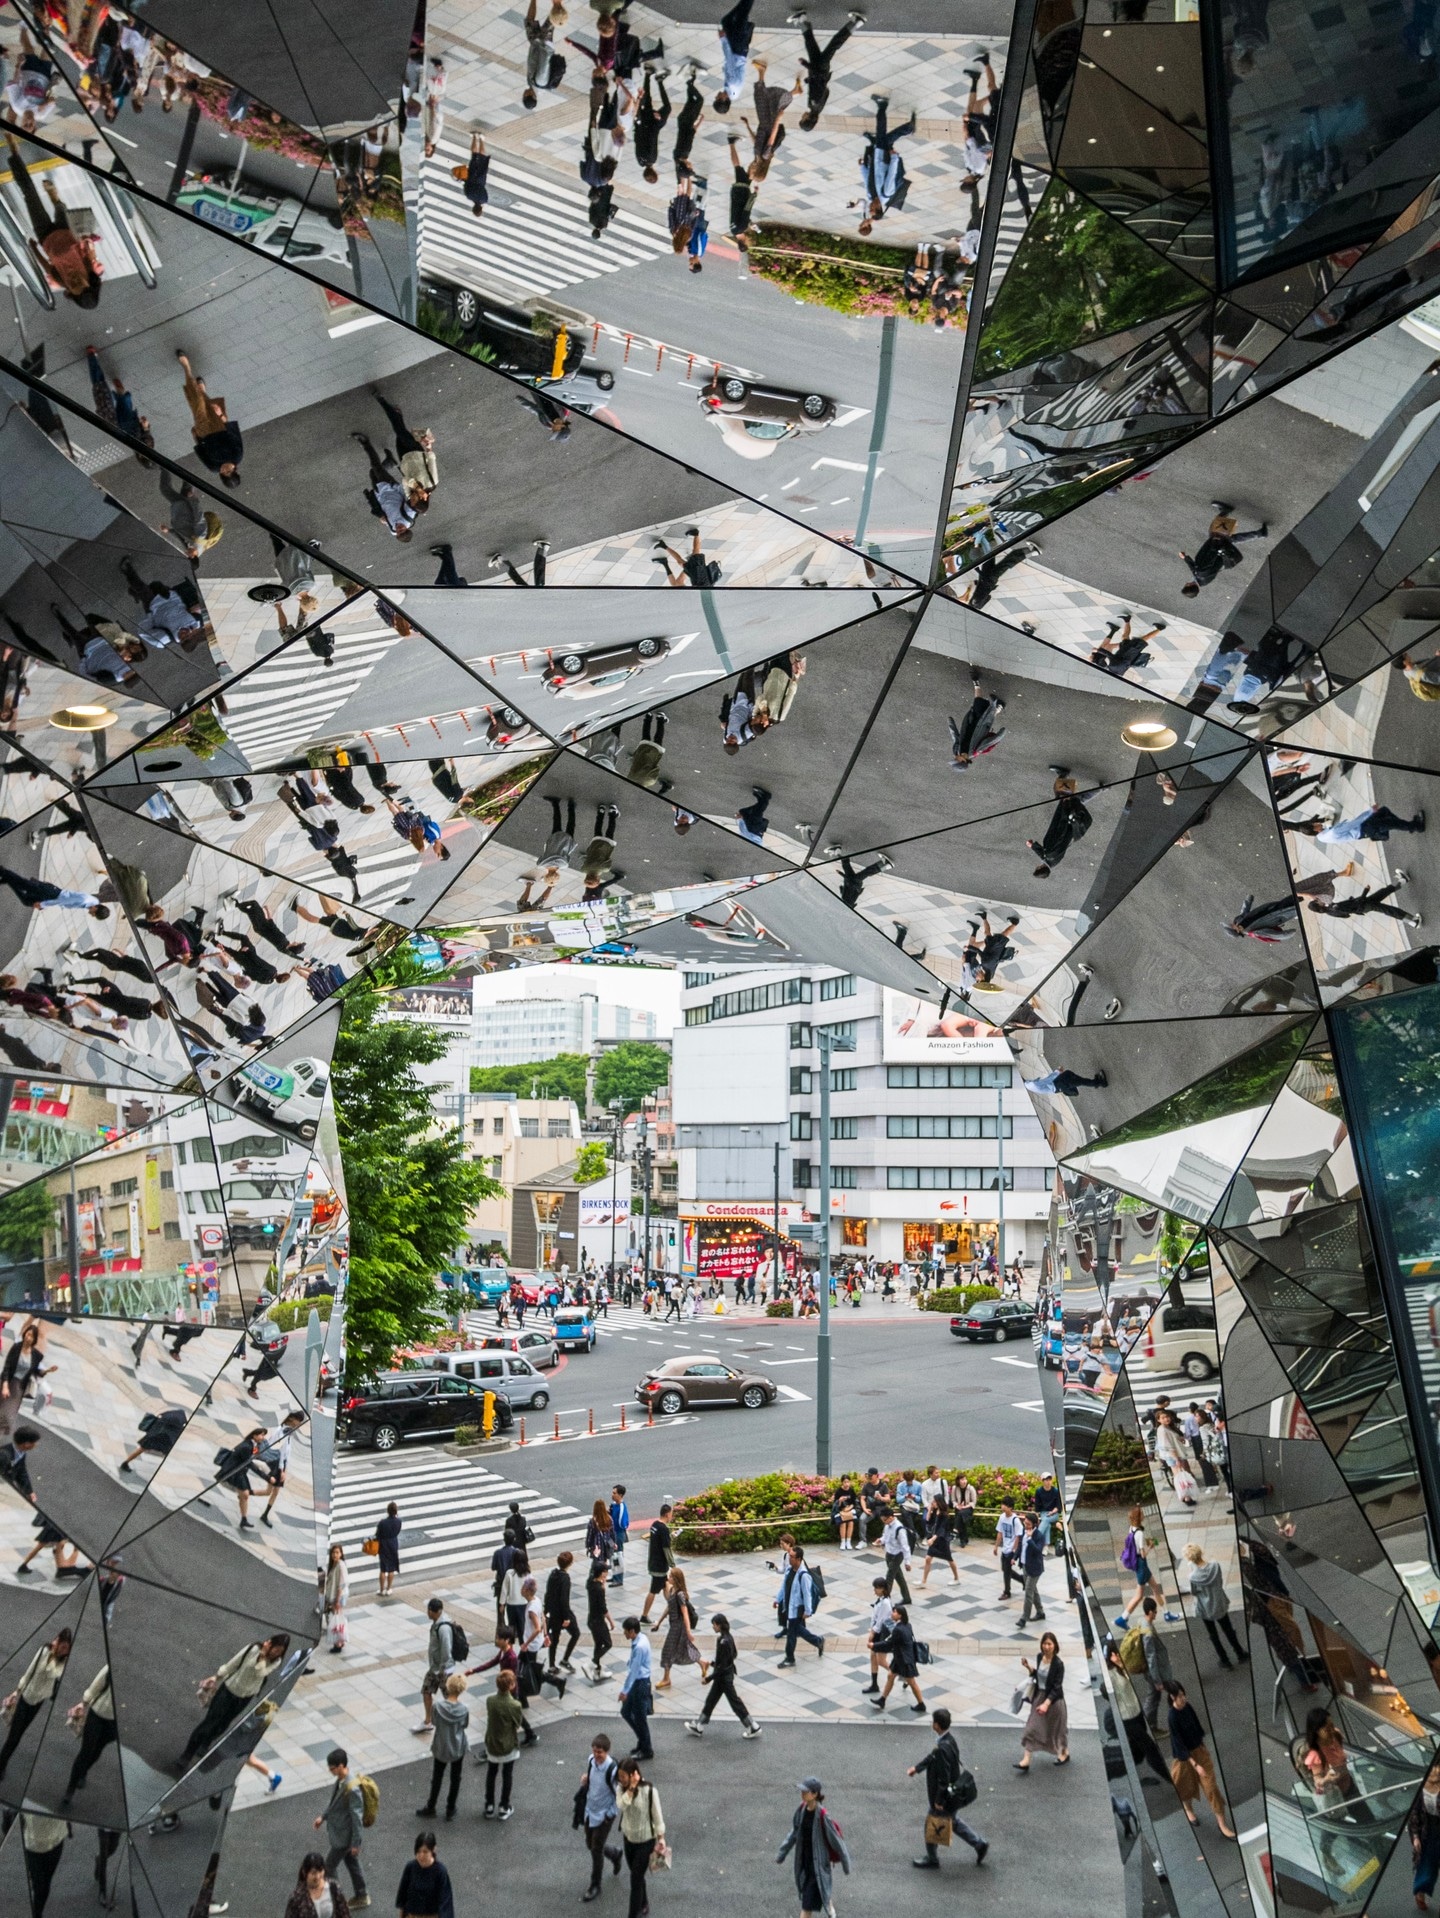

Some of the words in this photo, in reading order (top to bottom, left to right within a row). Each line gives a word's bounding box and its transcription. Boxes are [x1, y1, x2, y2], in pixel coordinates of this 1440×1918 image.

[928, 1041, 961, 1049] Amazon
[962, 1041, 994, 1049] Fashion
[706, 1204, 789, 1216] Condomana
